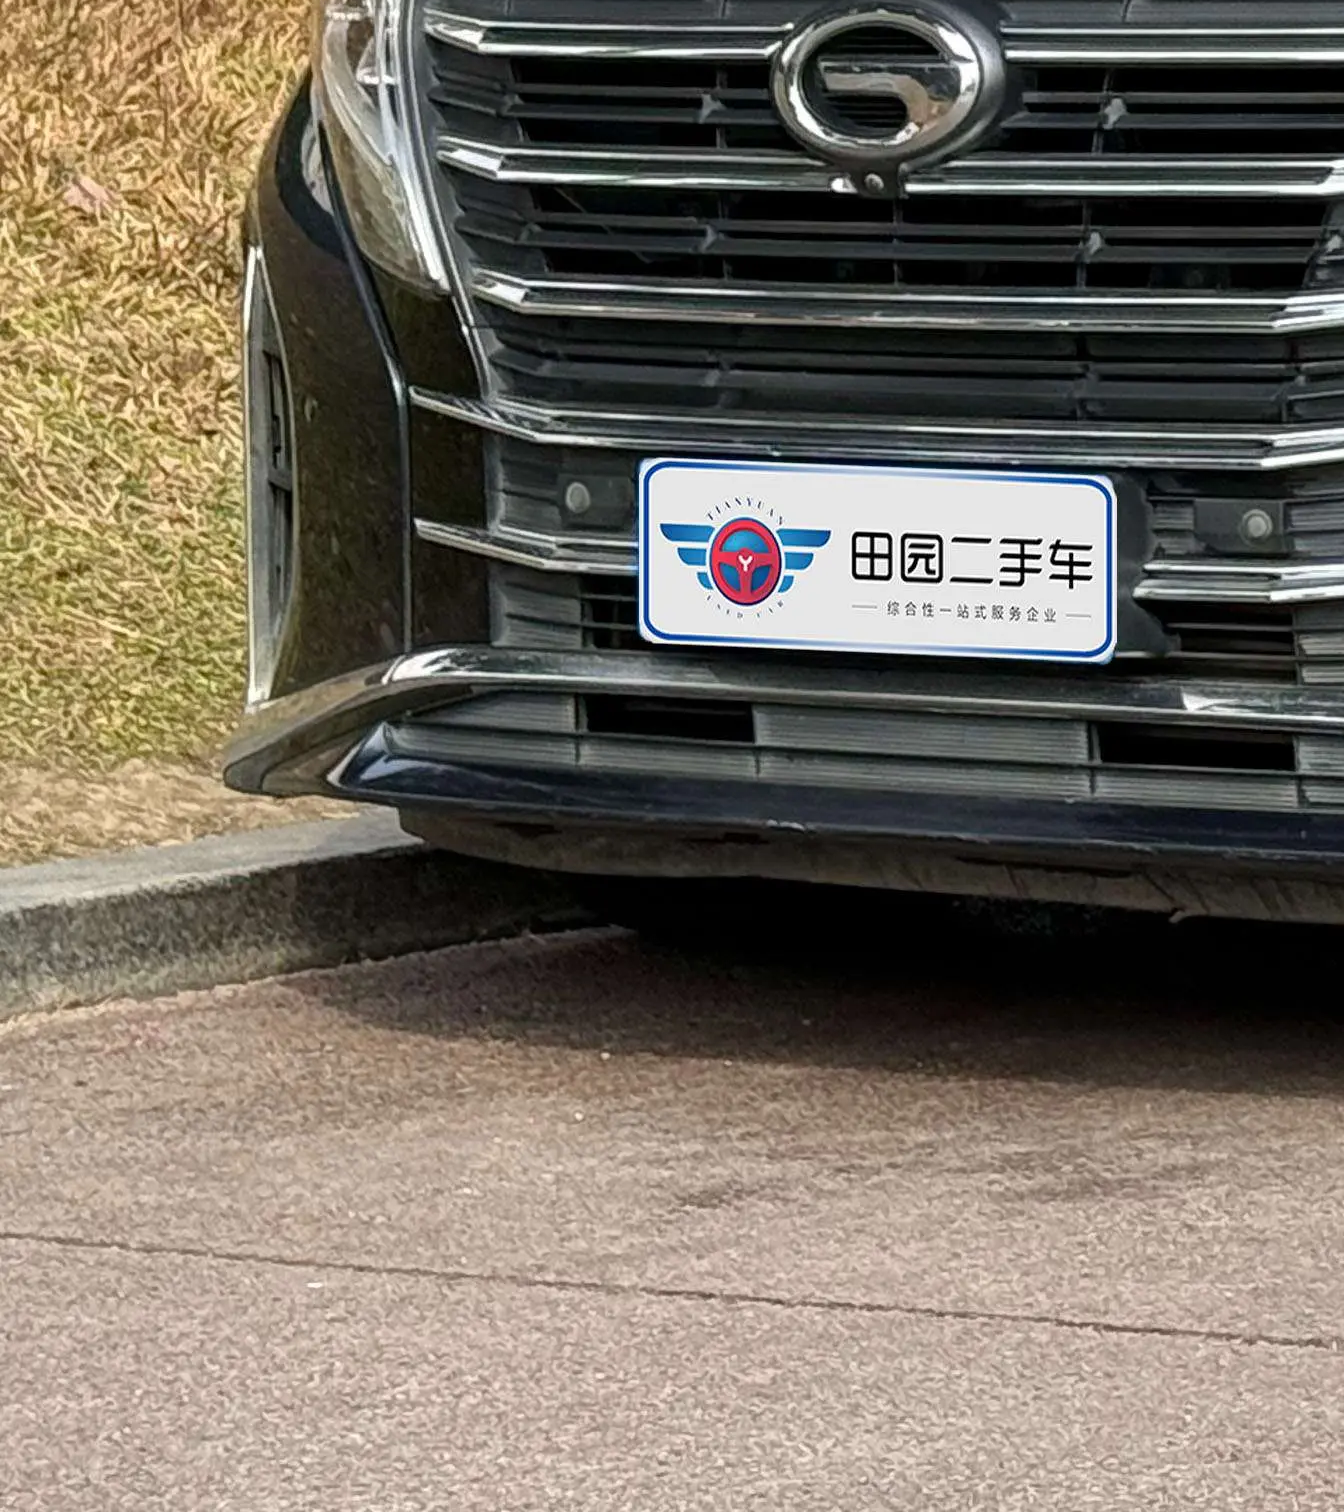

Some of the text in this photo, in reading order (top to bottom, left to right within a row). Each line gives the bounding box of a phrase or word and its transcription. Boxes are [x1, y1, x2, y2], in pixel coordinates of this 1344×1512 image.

[851, 531, 1093, 589] 田园二手车
[887, 600, 1057, 624] 综合性一站式服务企业
